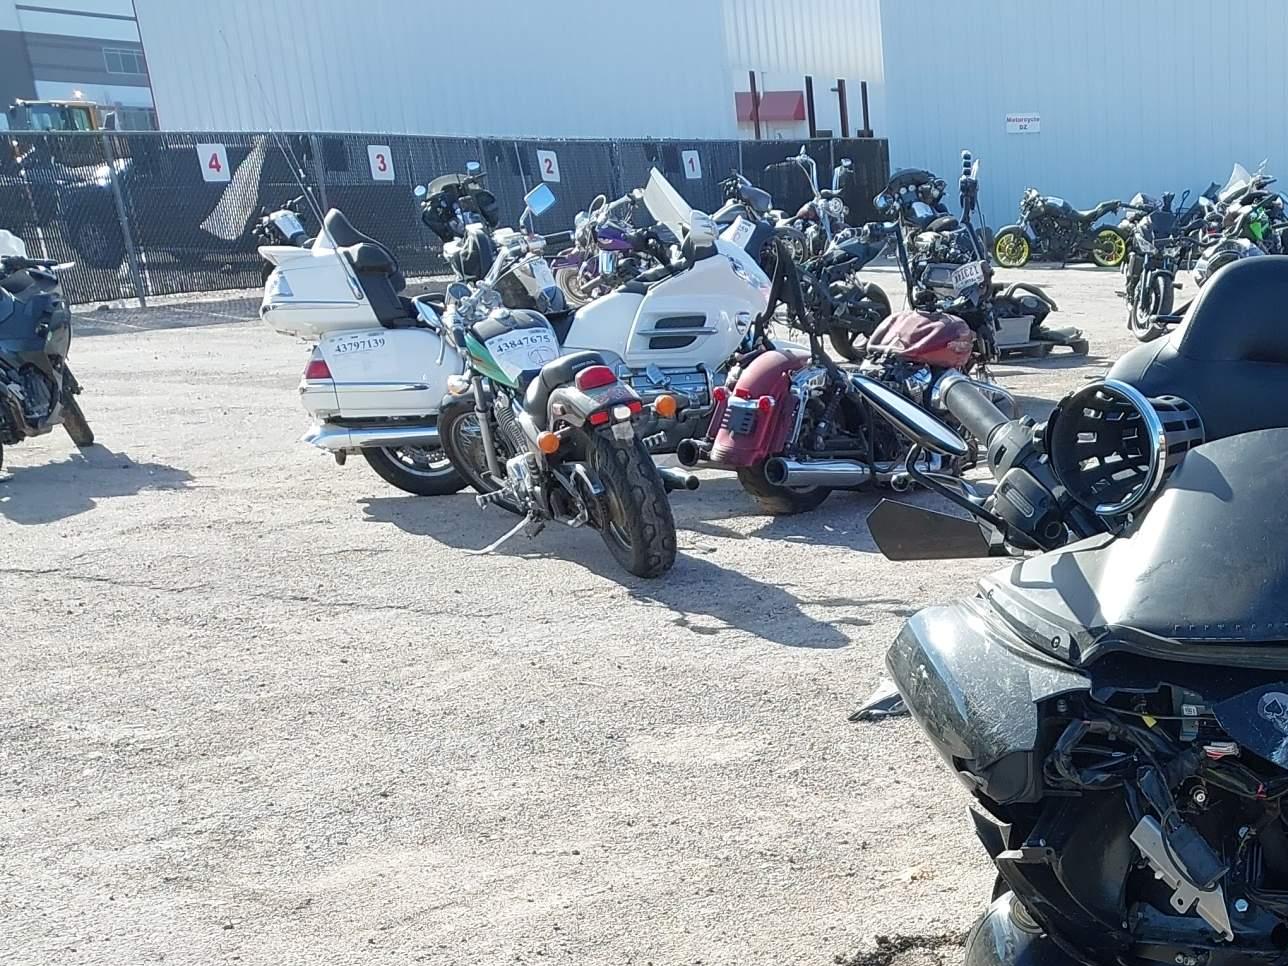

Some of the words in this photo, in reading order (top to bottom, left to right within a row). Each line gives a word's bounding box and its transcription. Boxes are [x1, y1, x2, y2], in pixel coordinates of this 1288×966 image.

[208, 153, 222, 173] 4
[375, 154, 388, 172] 3
[544, 158, 554, 174] 2
[688, 158, 695, 172] 1
[335, 337, 386, 353] 43797139
[496, 334, 551, 353] 43847675
